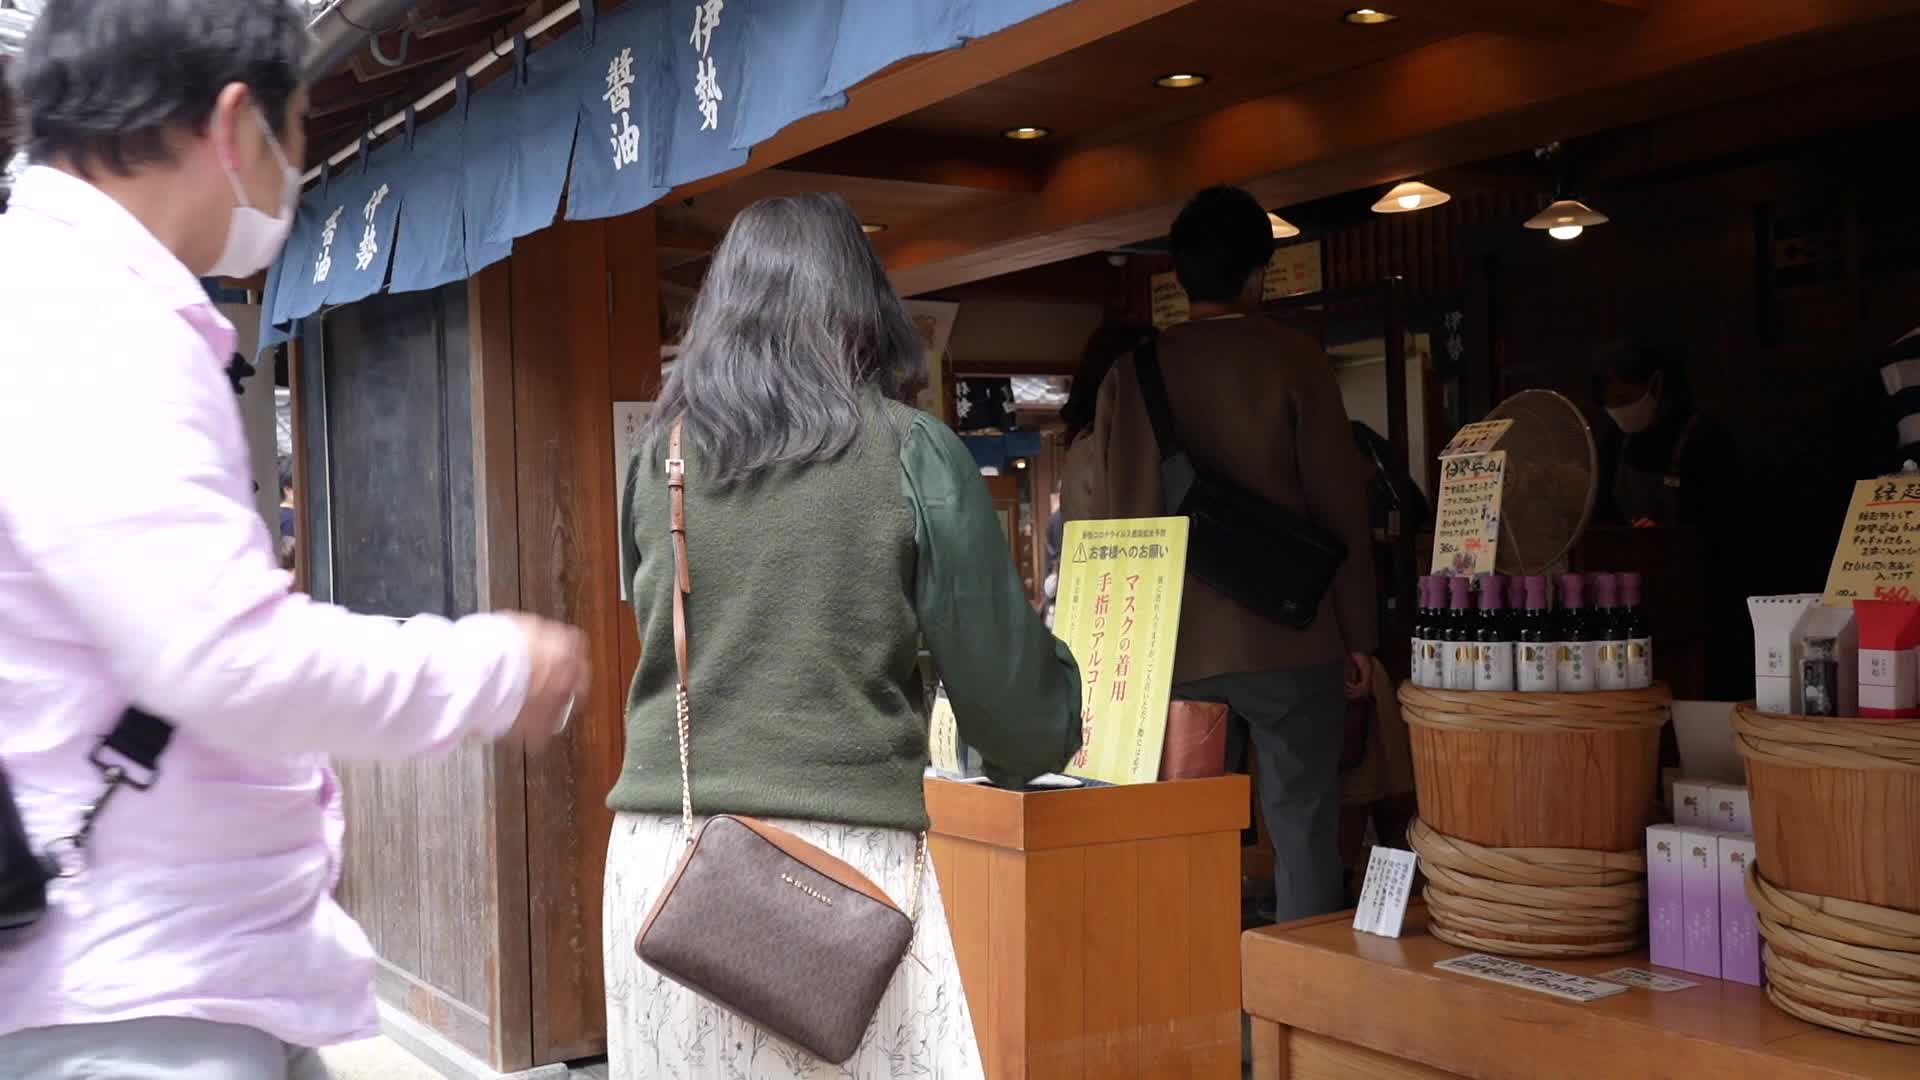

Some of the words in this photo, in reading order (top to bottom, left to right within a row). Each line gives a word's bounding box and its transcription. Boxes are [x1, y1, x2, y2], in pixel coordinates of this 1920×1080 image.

[690, 0, 723, 130] 伊勢
[354, 184, 389, 271] 伊勢
[1088, 543, 1169, 560] お客様へのお願い
[1111, 574, 1140, 702] マスクの着用
